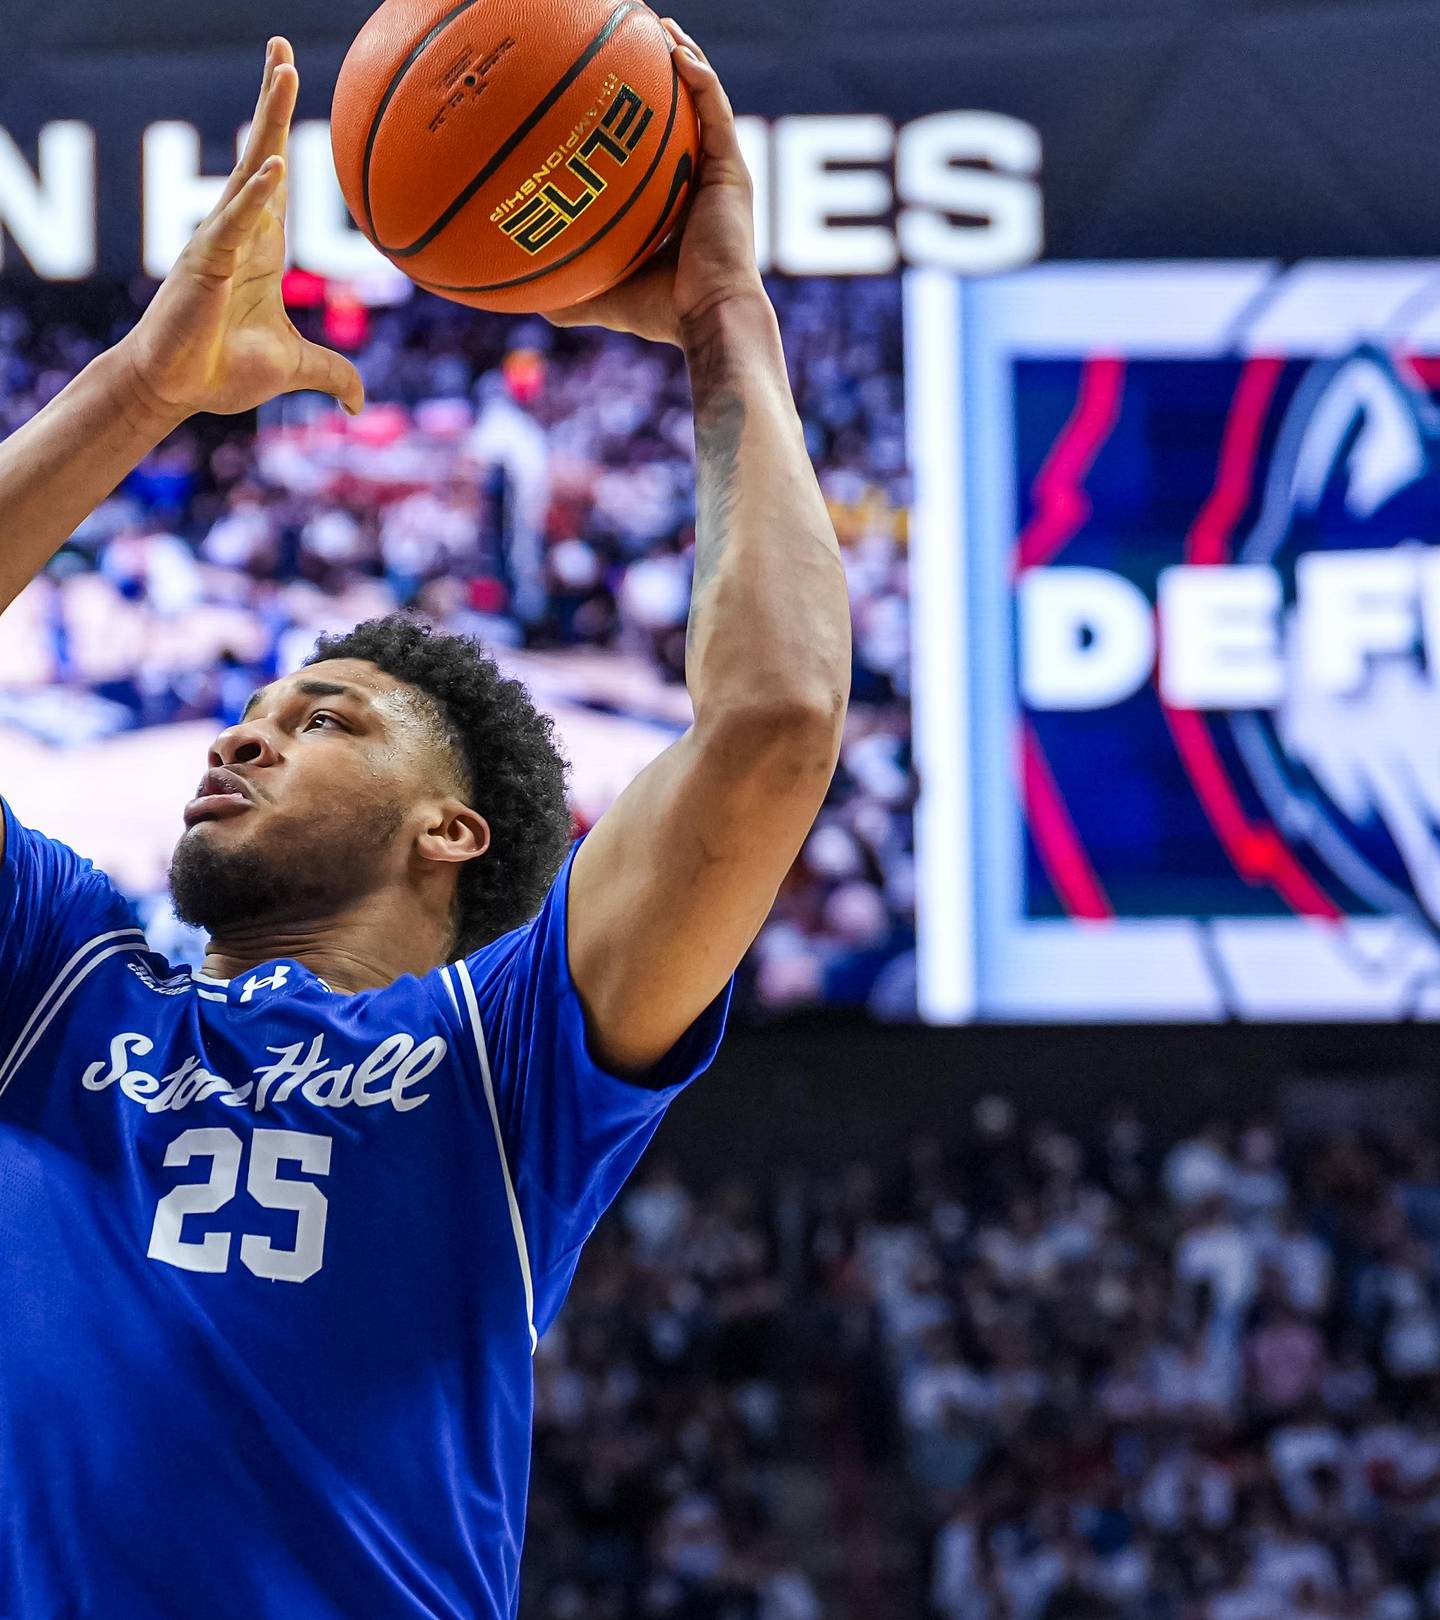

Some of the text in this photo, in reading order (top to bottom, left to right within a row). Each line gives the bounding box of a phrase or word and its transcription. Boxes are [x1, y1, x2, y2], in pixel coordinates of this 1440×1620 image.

[498, 82, 655, 256] ELITE
[81, 1032, 448, 1113] Seton Hall
[147, 1127, 333, 1283] 25
